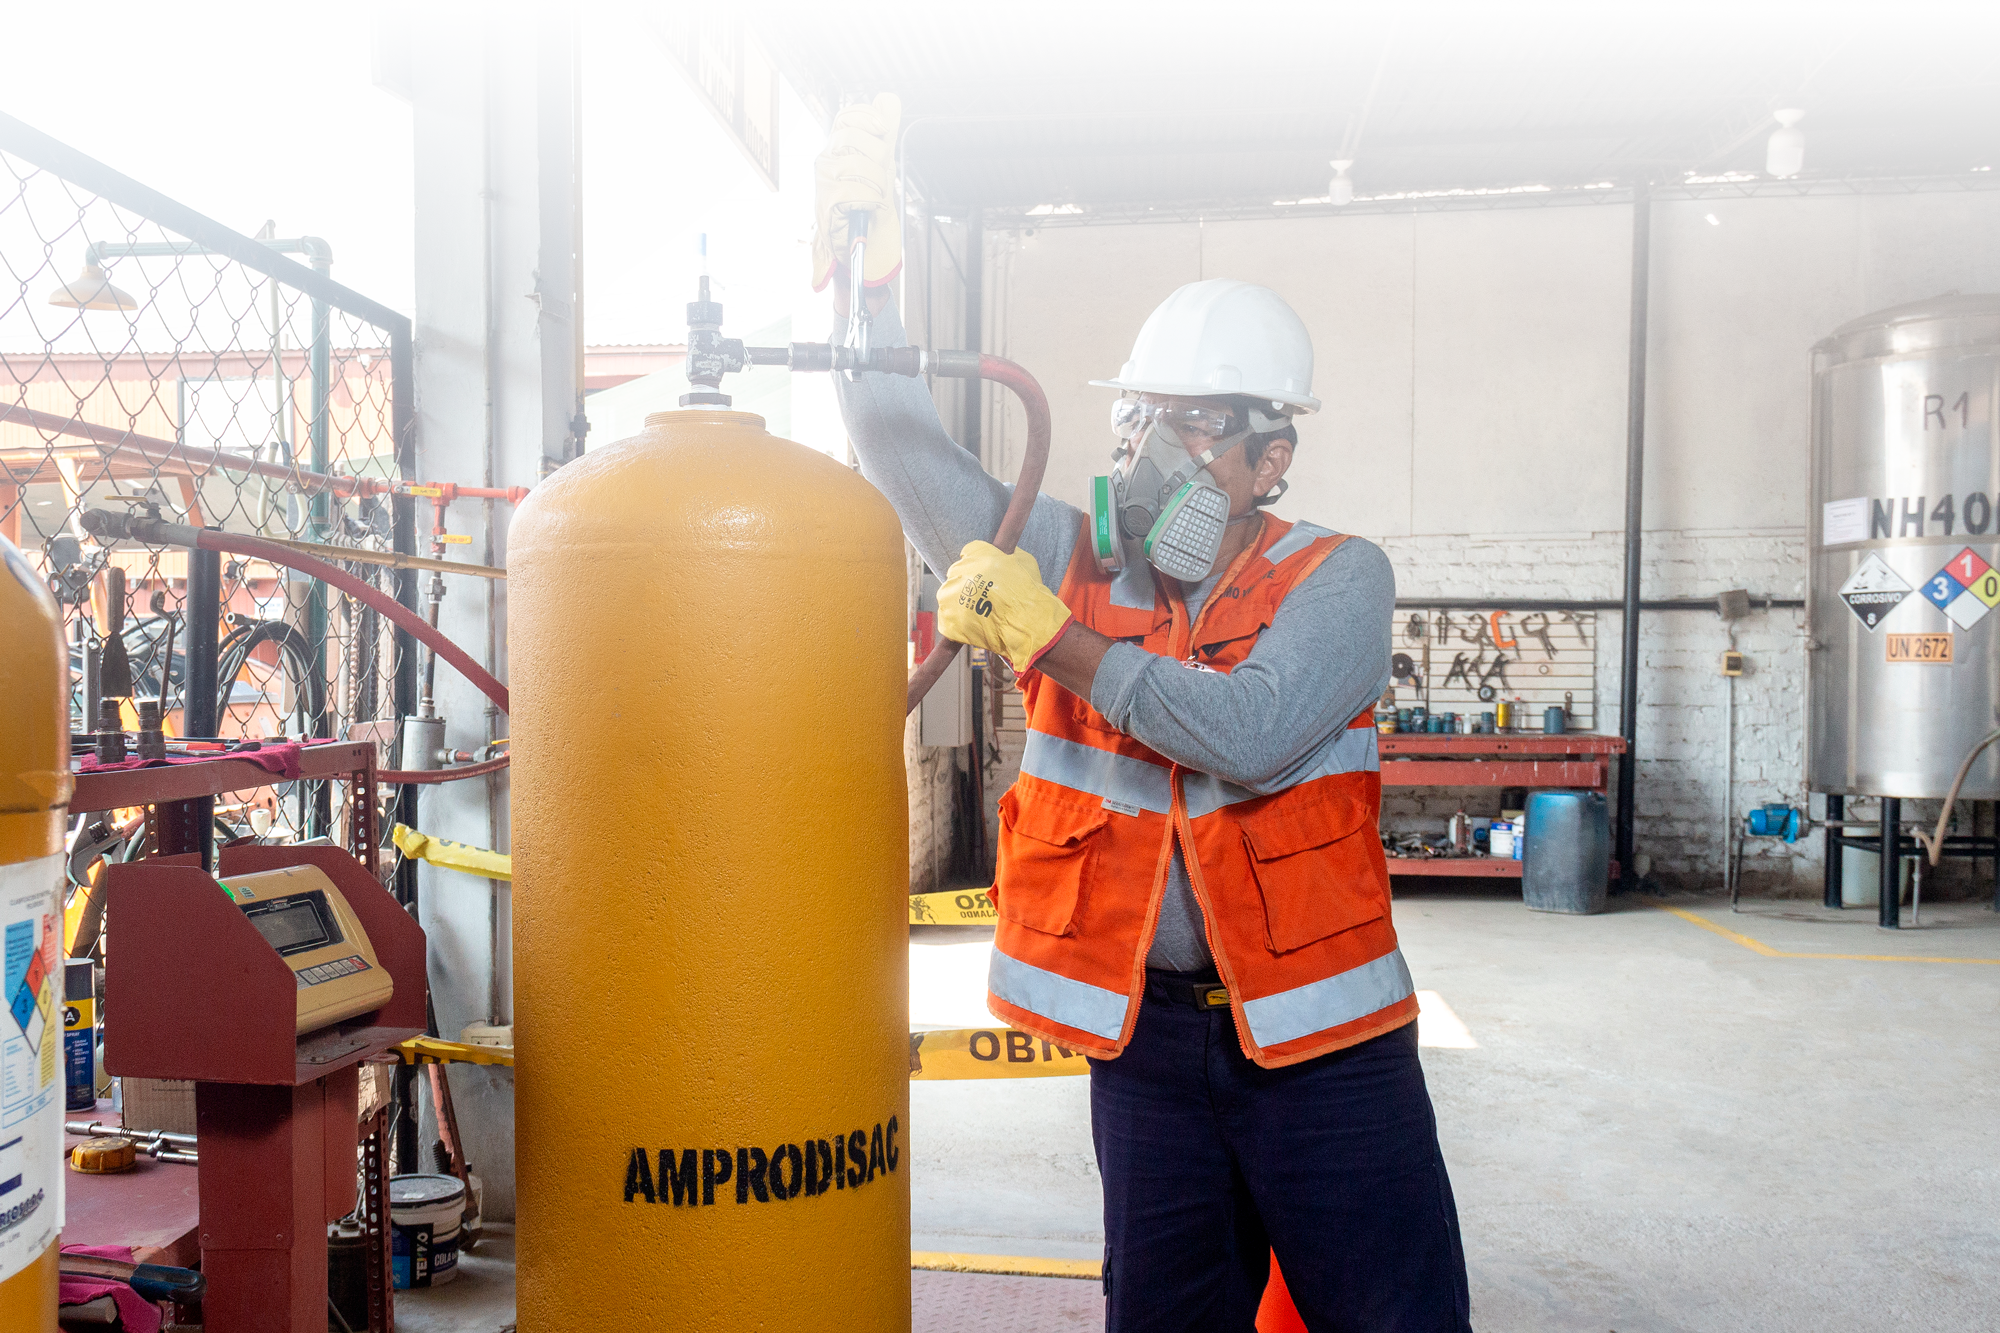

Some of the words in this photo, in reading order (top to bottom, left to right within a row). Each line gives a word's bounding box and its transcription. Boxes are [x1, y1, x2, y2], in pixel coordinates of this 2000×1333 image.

[1924, 391, 1969, 431] R1
[1960, 554, 1973, 578] 1
[981, 581, 994, 598] pro
[1849, 592, 1902, 605] CORROSIVO
[1932, 576, 1949, 600] 3
[1985, 576, 1997, 597] 0
[975, 597, 993, 618] S
[1866, 613, 1877, 626] 8
[1889, 638, 1911, 658] UN
[1915, 637, 1949, 659] 2672
[624, 1114, 899, 1206] AMPRODISAC
